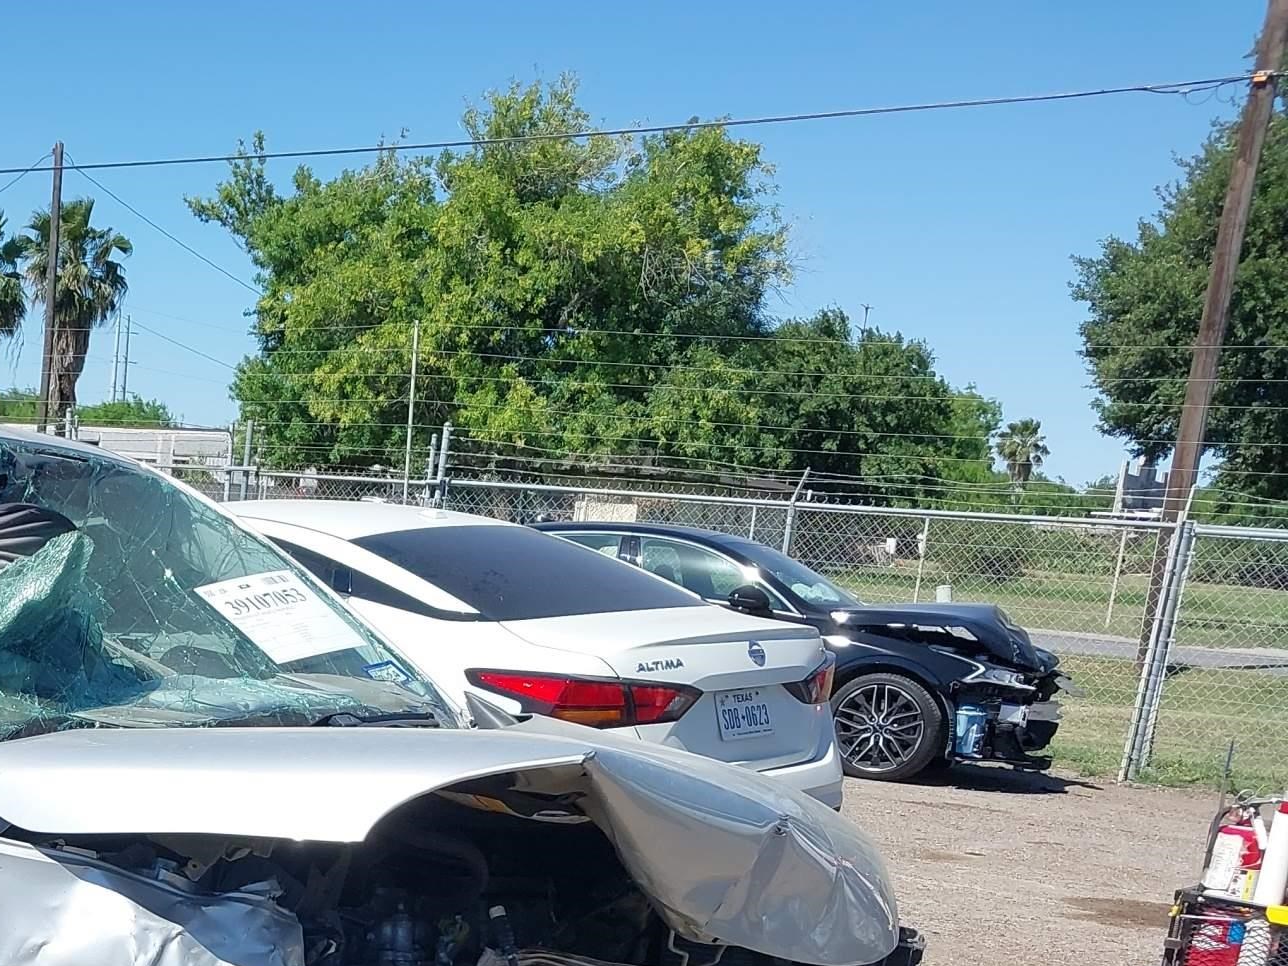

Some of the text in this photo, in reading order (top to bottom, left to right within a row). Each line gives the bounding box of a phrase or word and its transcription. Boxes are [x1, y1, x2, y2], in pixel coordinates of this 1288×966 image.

[224, 587, 307, 616] 39107053
[635, 657, 685, 673] ALTIMA
[732, 692, 753, 704] TEXAS
